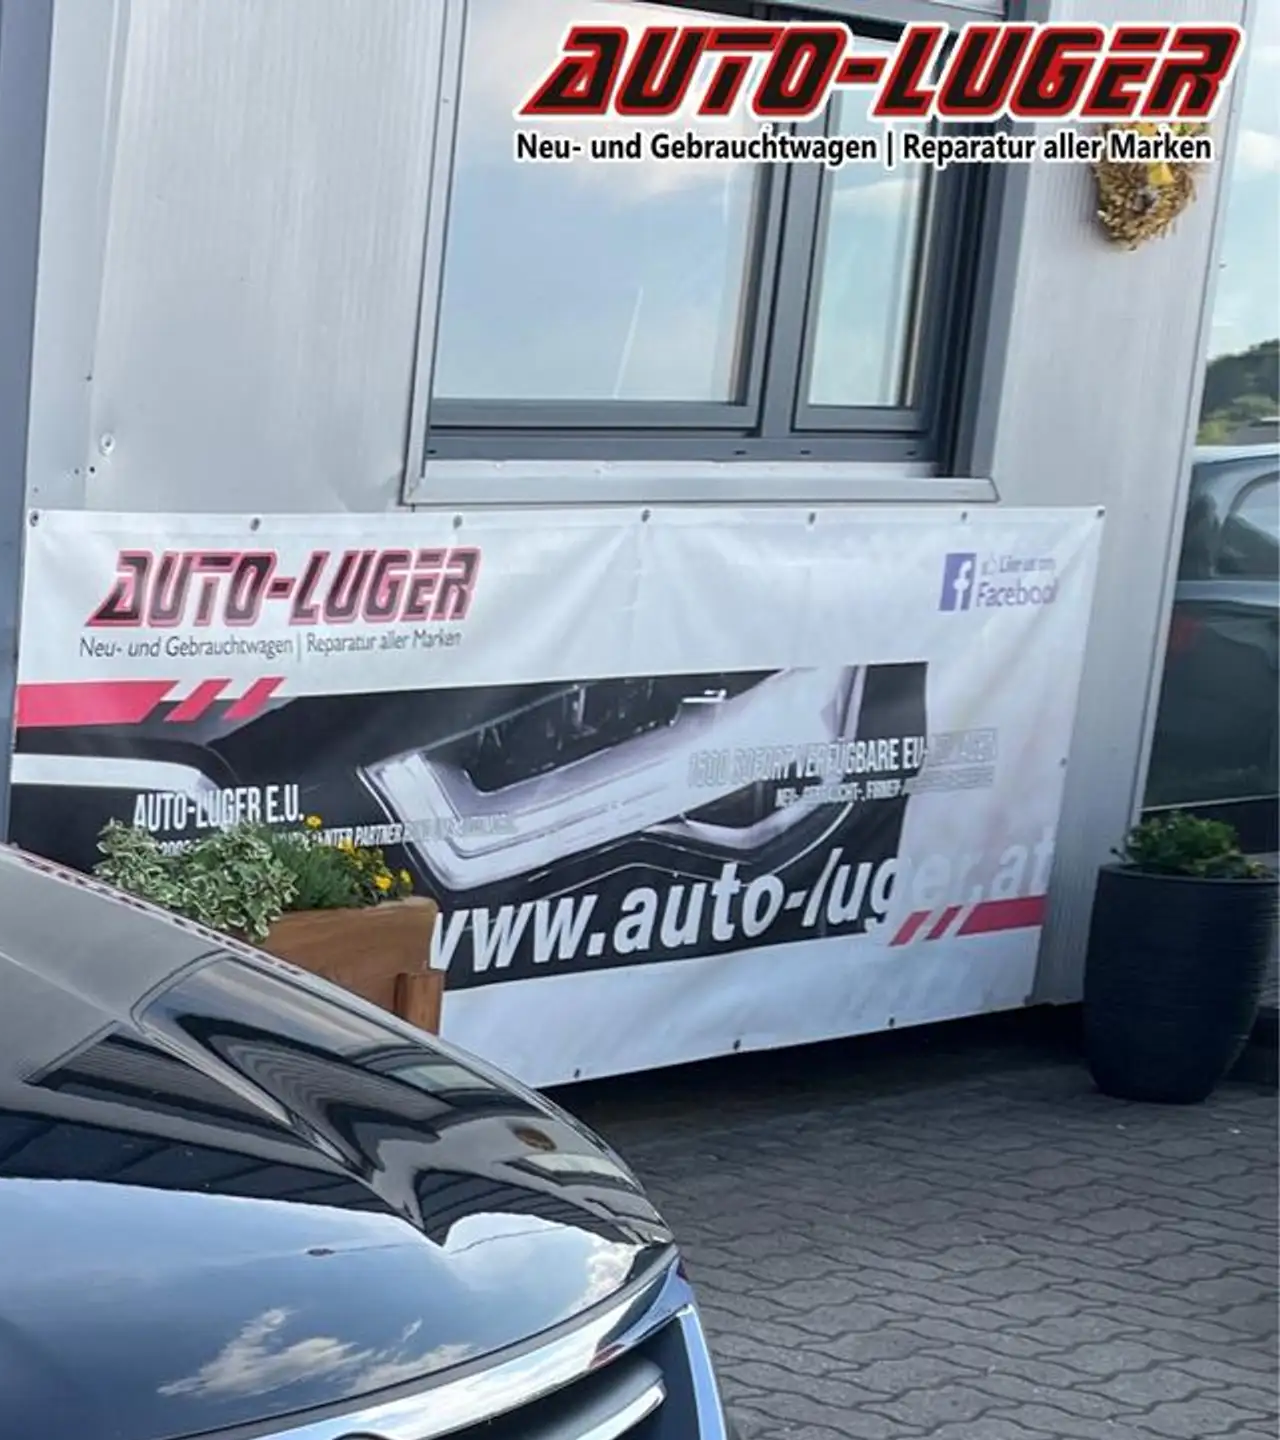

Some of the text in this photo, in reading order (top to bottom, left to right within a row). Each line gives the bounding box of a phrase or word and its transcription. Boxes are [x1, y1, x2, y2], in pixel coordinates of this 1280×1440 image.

[85, 547, 481, 628] AUTO-LUGER
[79, 628, 463, 661] Neu- und Gebrauchtwagen Reparatur aller Marken
[133, 783, 305, 834] AUTO-LUGER E.U.
